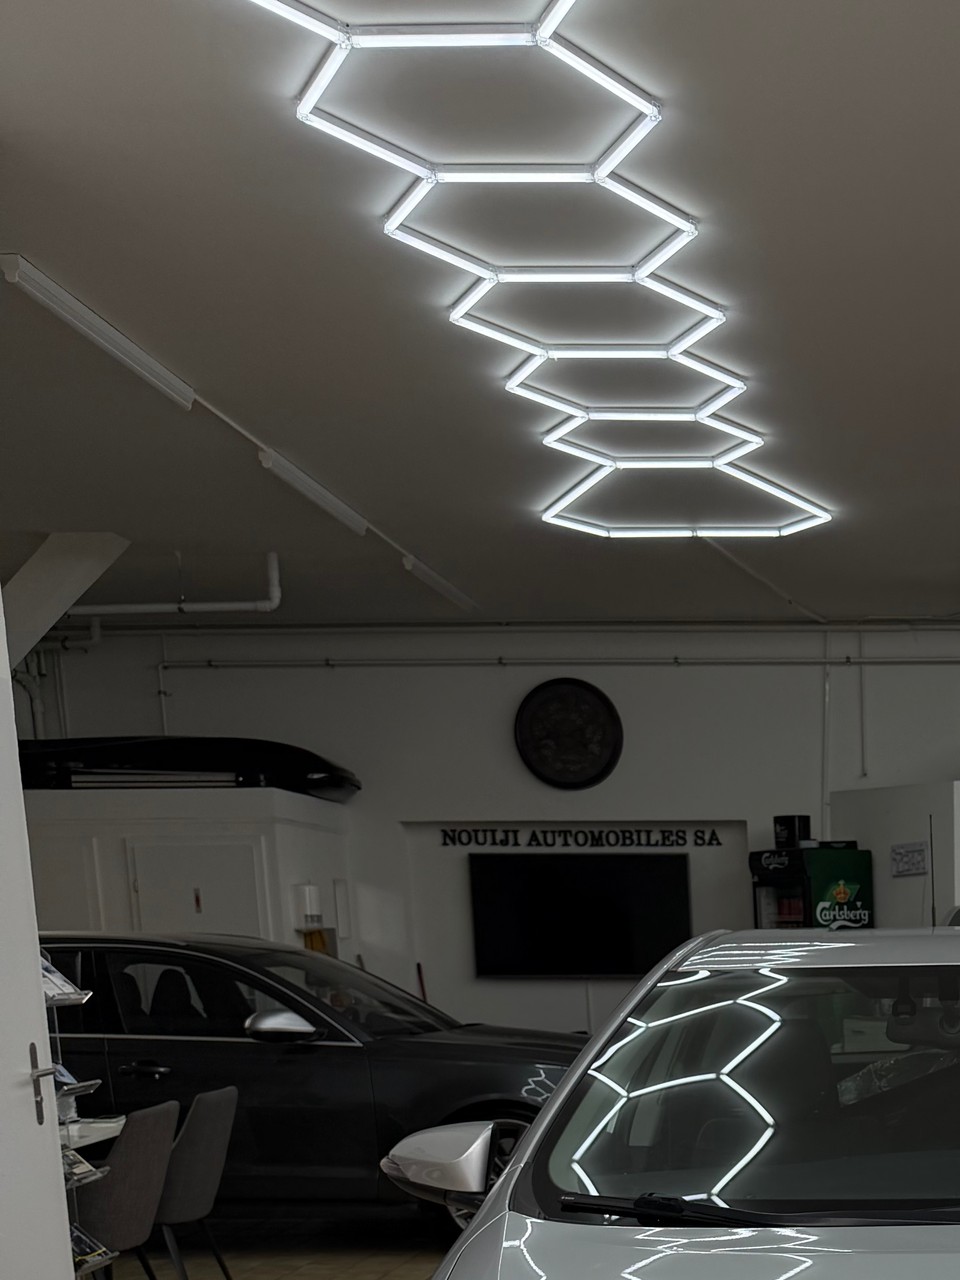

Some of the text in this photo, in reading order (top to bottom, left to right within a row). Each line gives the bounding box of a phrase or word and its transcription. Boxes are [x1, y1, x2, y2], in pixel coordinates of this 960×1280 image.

[441, 829, 723, 847] NOUIJI AUTOMOBILES SA
[816, 901, 869, 929] Carlsberg
